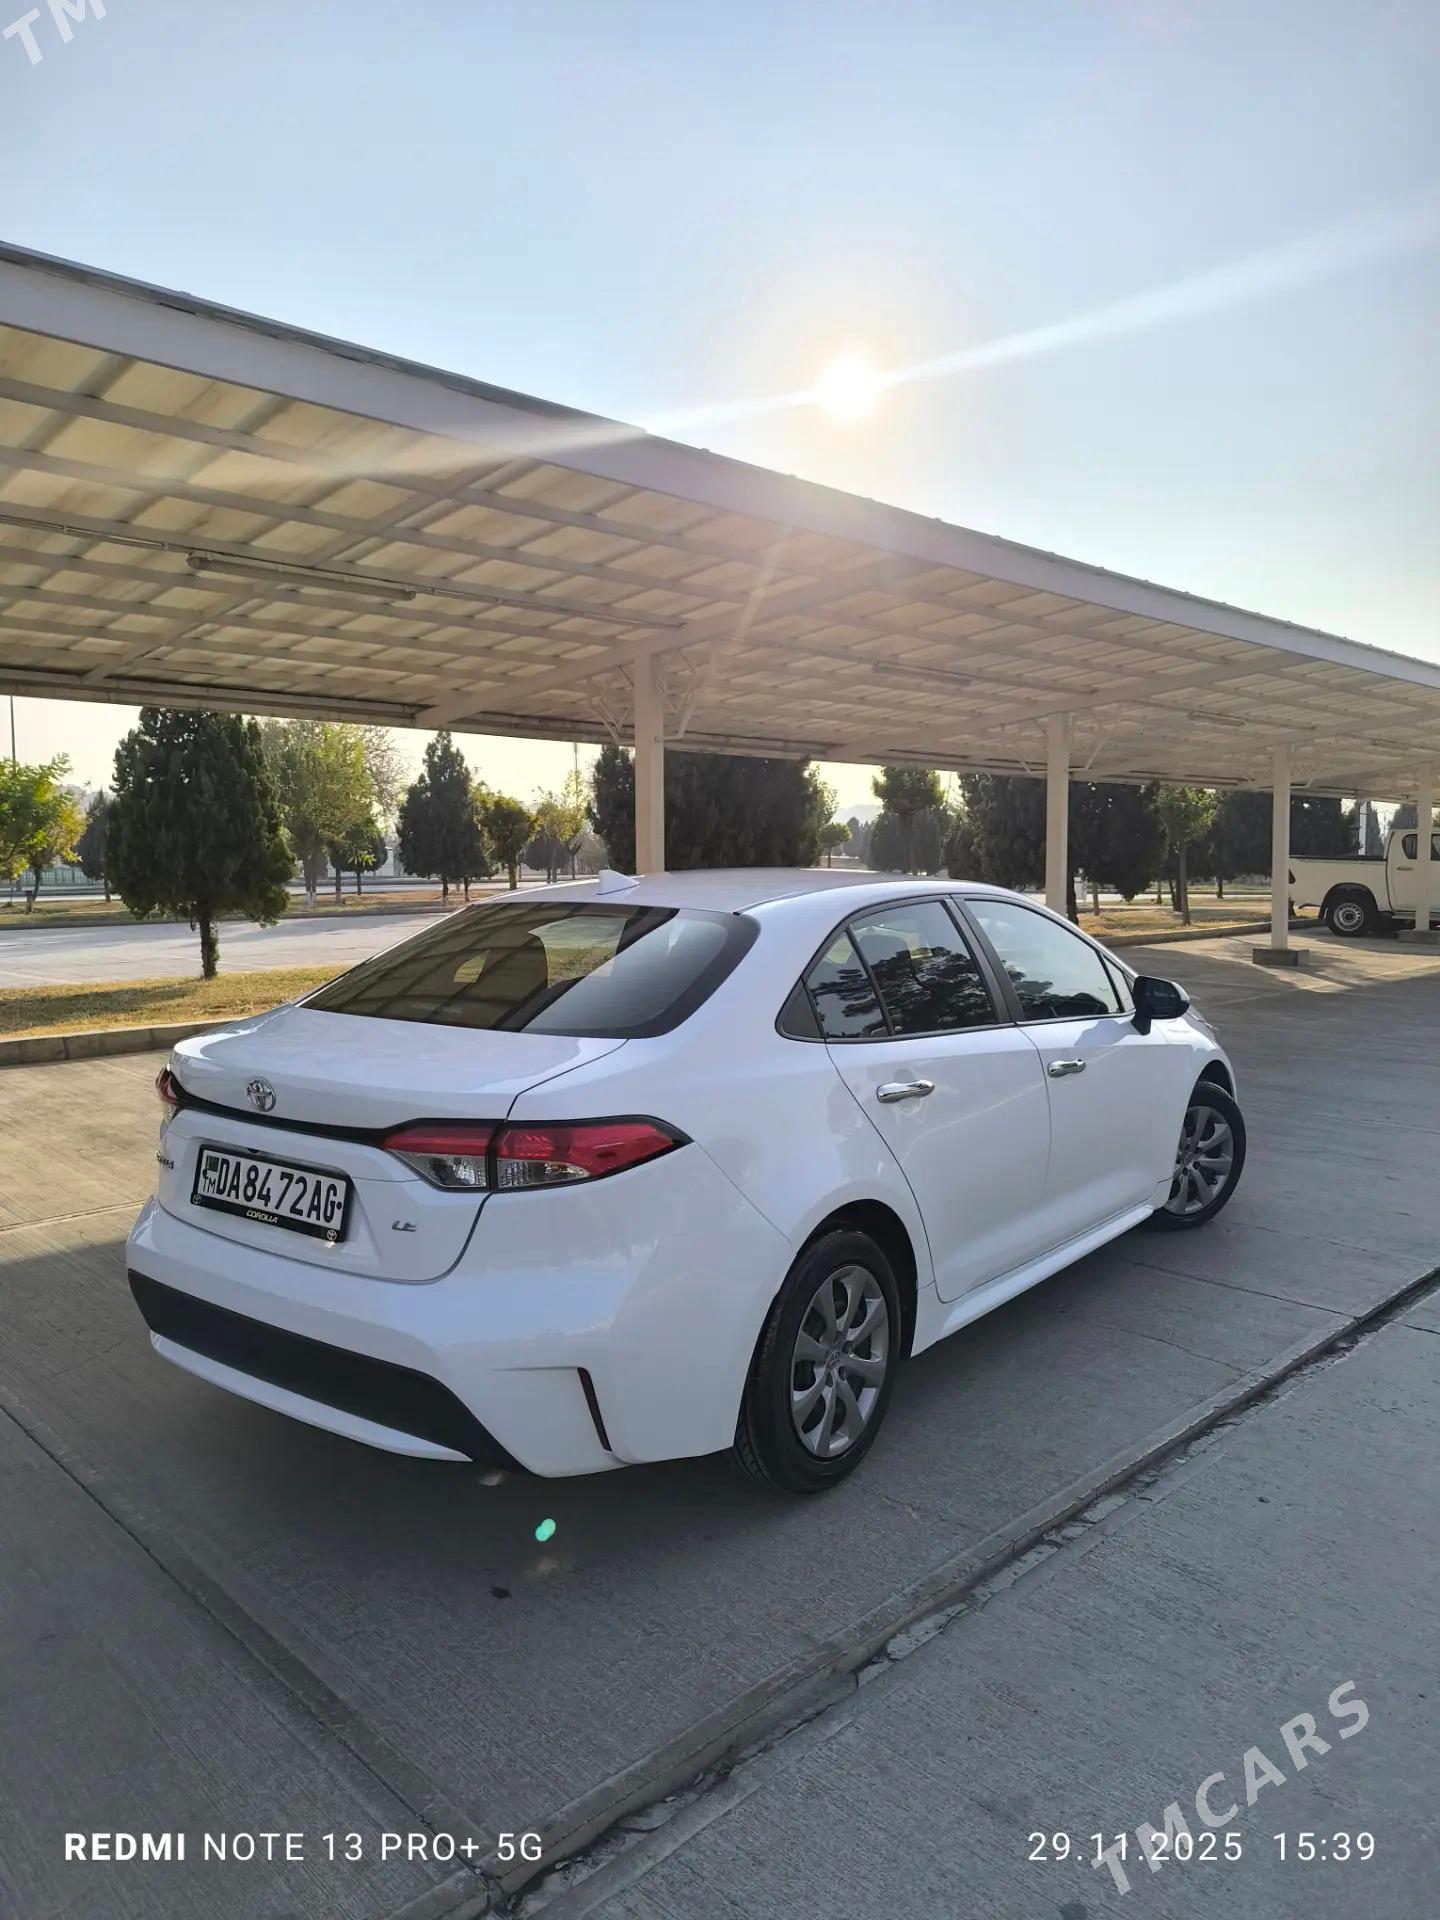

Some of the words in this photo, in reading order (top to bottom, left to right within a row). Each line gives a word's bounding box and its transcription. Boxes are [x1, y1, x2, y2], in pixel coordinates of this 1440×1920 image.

[202, 1175, 217, 1195] TM
[246, 1209, 279, 1224] COROLLA
[391, 1219, 417, 1233] LE
